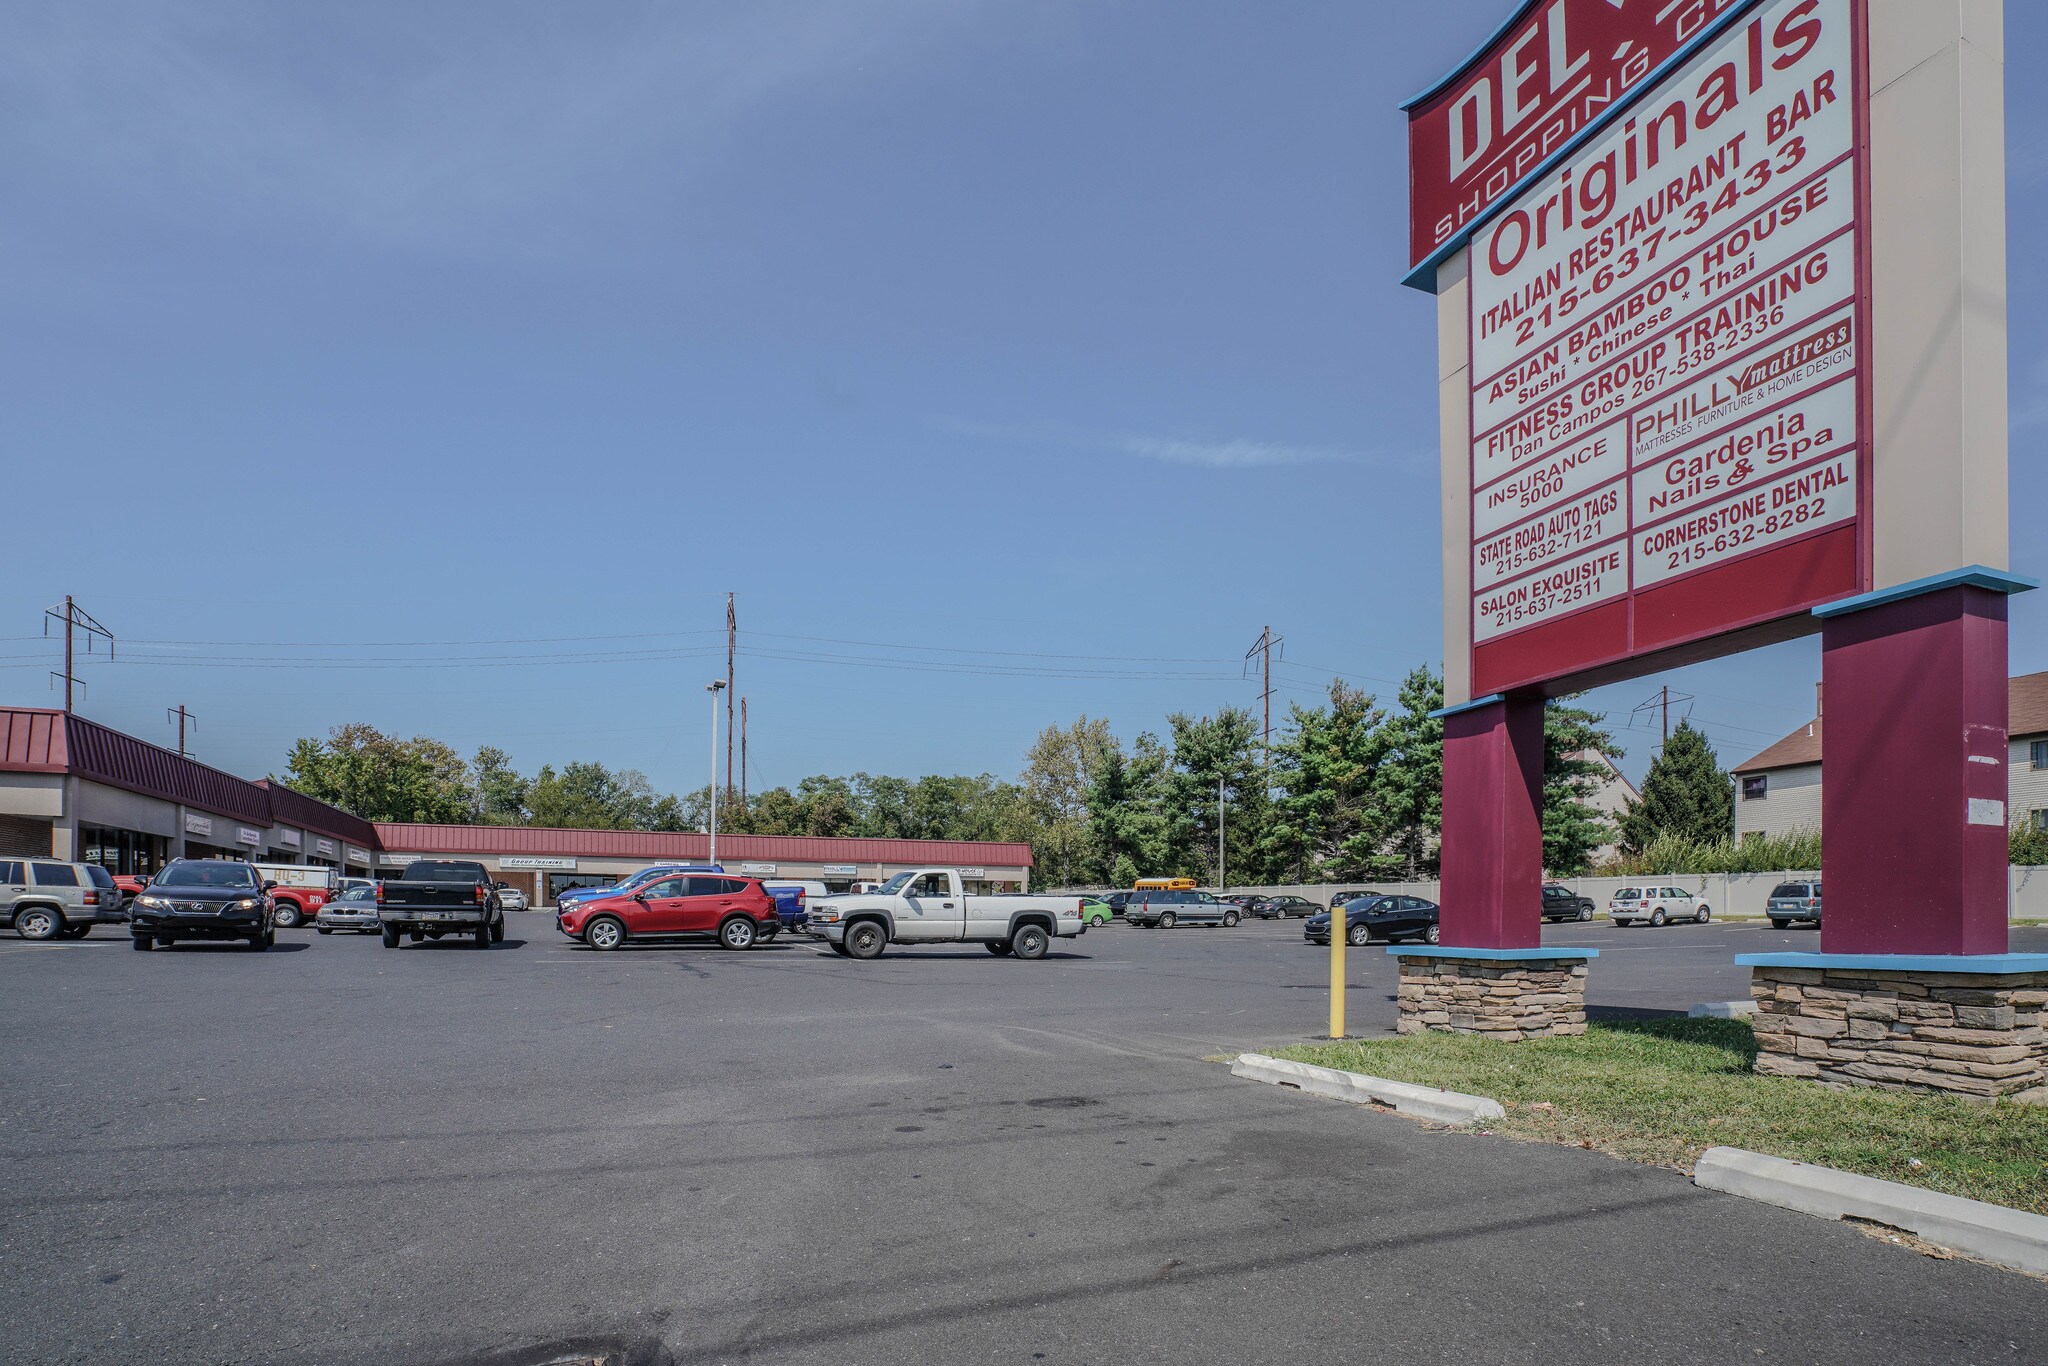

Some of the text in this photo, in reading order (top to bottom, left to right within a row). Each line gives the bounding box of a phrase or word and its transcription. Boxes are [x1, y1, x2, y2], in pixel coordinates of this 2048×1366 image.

[1435, 47, 1649, 244] SHOPPING
[1489, 0, 1822, 276] Originals
[1482, 70, 1836, 340] ITALIAN RESTAURANT BAR
[1516, 136, 1806, 347] 215-637-3433
[1489, 178, 1828, 404] ASIAN BAMBOO HOUSE
[1518, 256, 1754, 404] Sushi Chinese Thai
[1489, 252, 1828, 458] FITNESS GROUP TRAINING
[1512, 305, 1784, 462] Dan Campos 267-538-2336
[1750, 326, 1847, 386] mattress
[1636, 346, 1851, 454] MATTRESSES FURNITURE & HOME DESIGN
[1489, 438, 1606, 508] INSURANCE
[1520, 477, 1563, 508] 5000
[1650, 428, 1833, 513] Nails & Spa
[1666, 413, 1804, 485] Gardenia
[1480, 490, 1617, 566] STATE ROAD AUTO TAGS
[1496, 520, 1600, 575] 215-632-7121
[1642, 462, 1848, 556] CORNERSTONE DENTAL
[1668, 498, 1825, 570] 215-632-8282
[1481, 551, 1619, 616] SALON EXQUISITE
[1496, 577, 1600, 627] 215-637-2511
